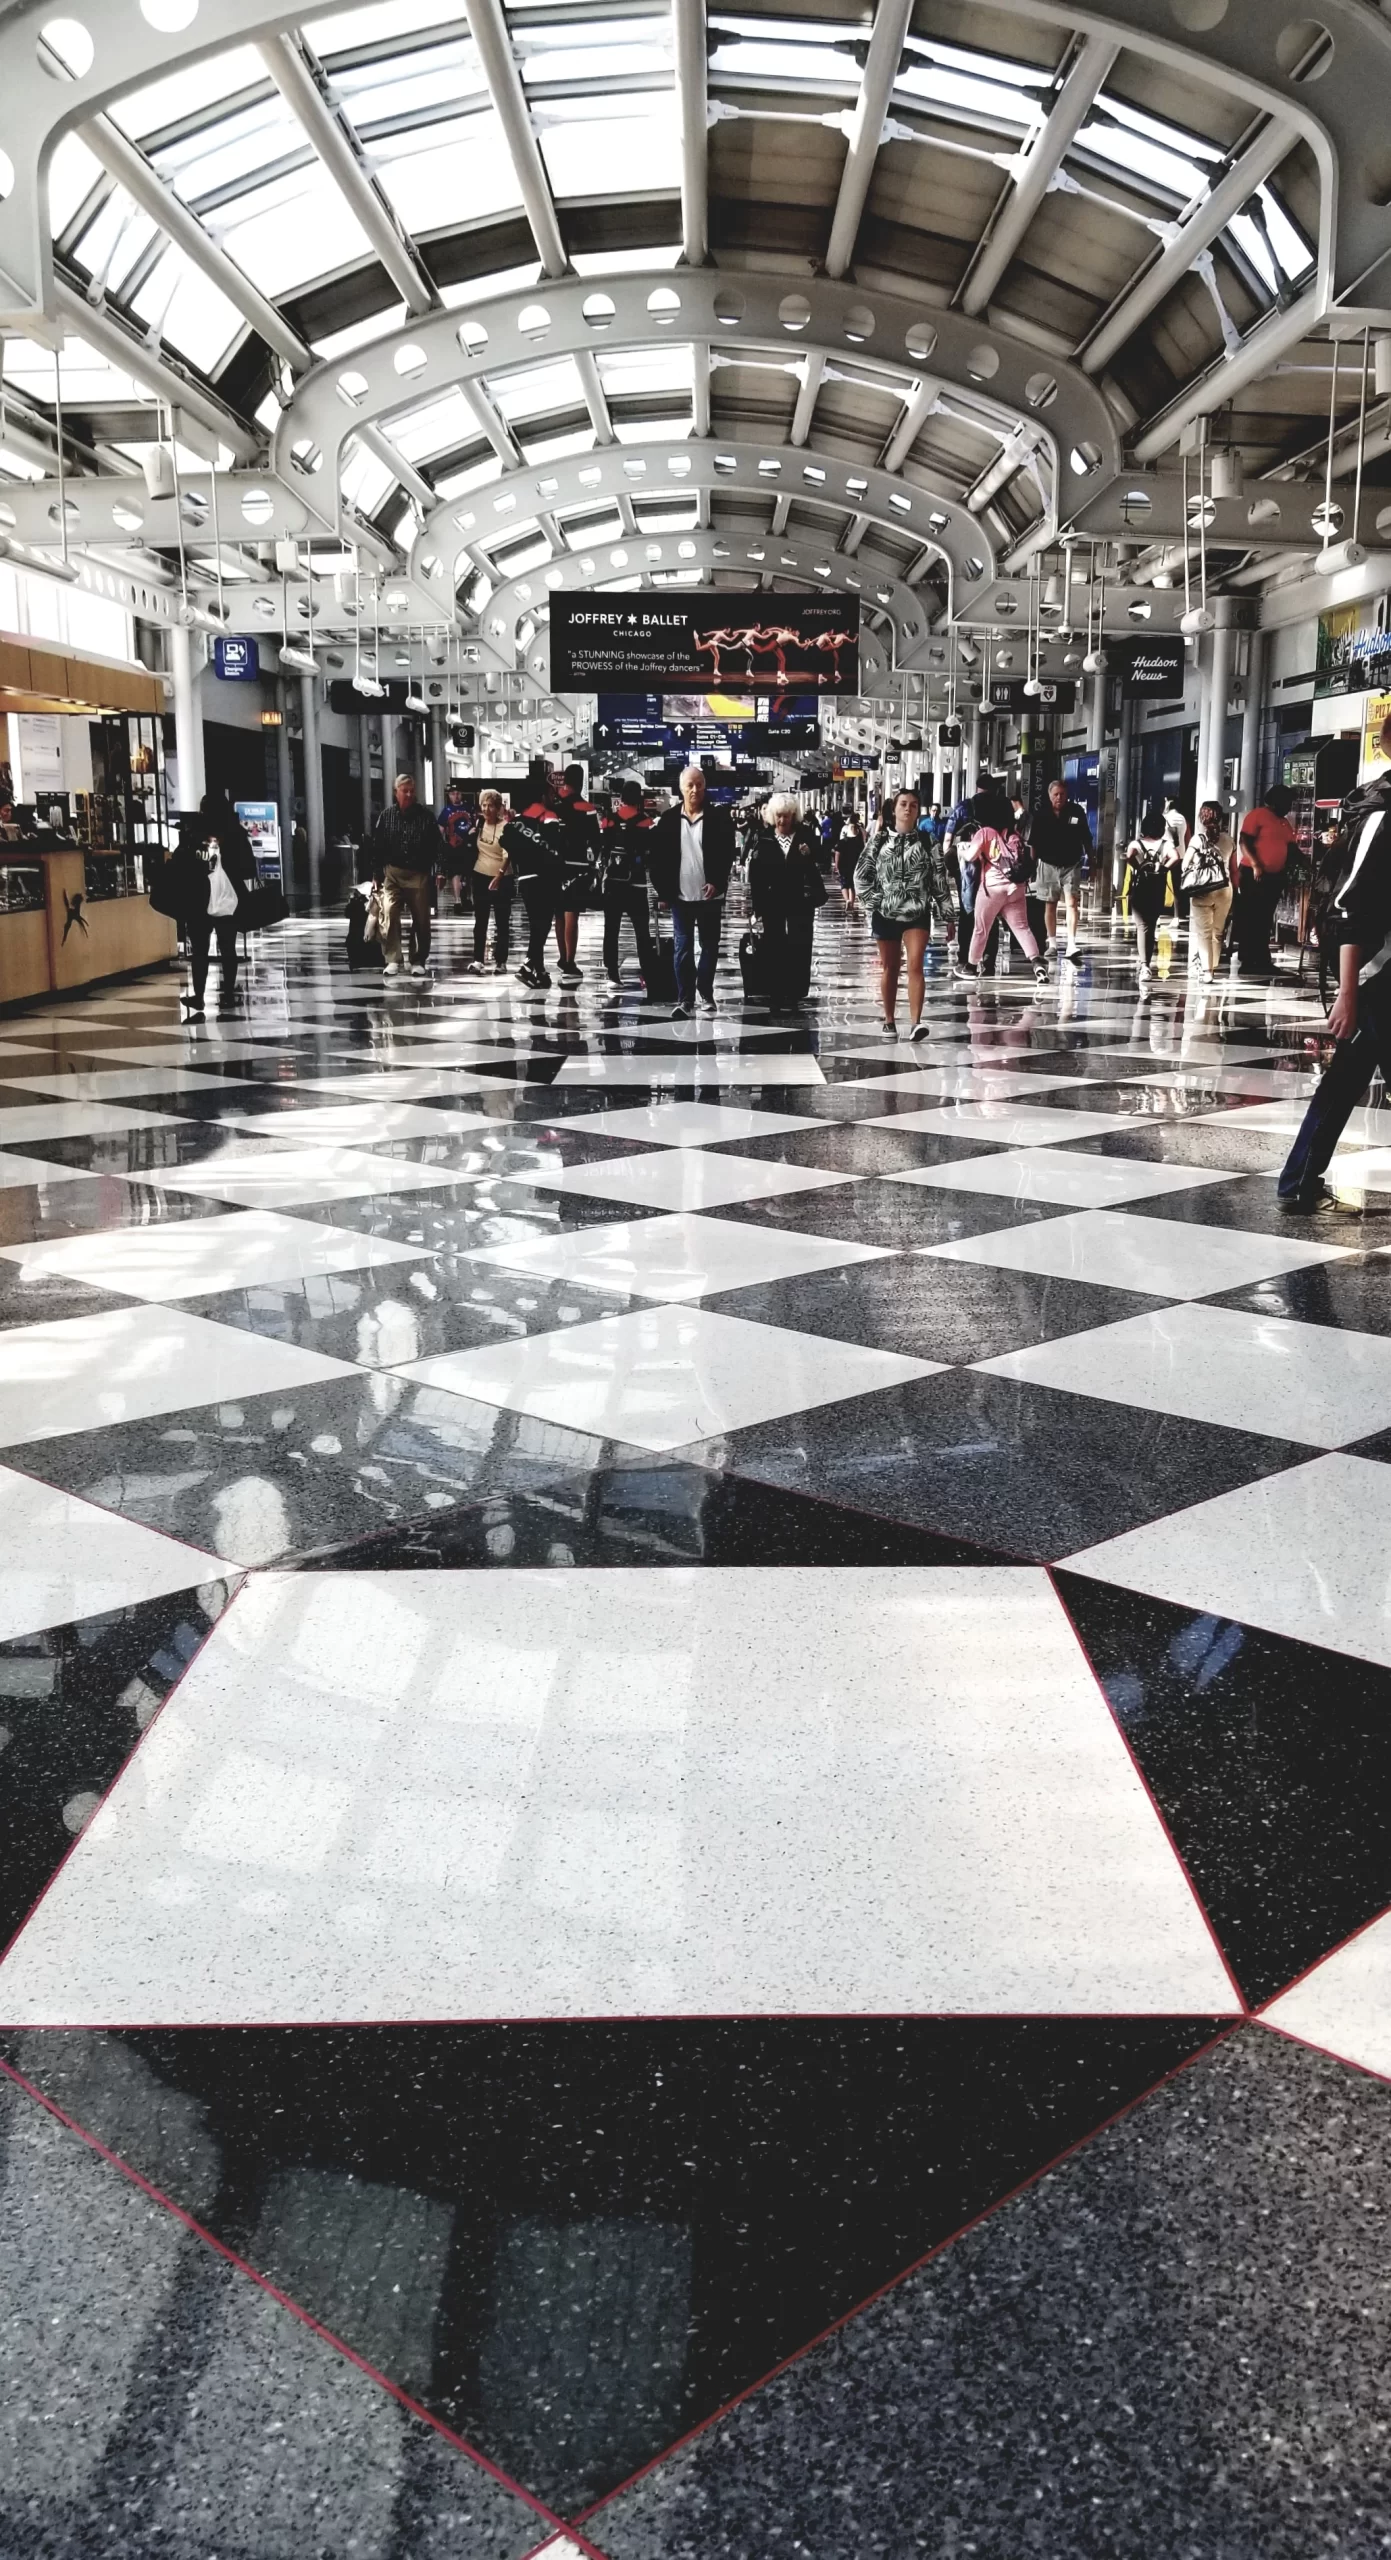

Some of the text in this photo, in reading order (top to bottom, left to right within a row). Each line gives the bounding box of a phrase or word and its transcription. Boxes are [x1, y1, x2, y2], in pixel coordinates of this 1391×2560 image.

[568, 613, 688, 626] JOFFREY BALLET
[578, 650, 625, 659] STUNNING
[626, 651, 665, 660] showcase
[666, 651, 676, 660] of
[677, 652, 690, 661] the
[1131, 655, 1178, 668] Hudson
[571, 661, 613, 670] PROWESS
[614, 661, 624, 671] of
[625, 662, 638, 671] the
[640, 662, 667, 674] Joffrey
[1131, 669, 1168, 681] News
[1035, 760, 1043, 791] NEAR
[1107, 755, 1116, 793] WOMEN
